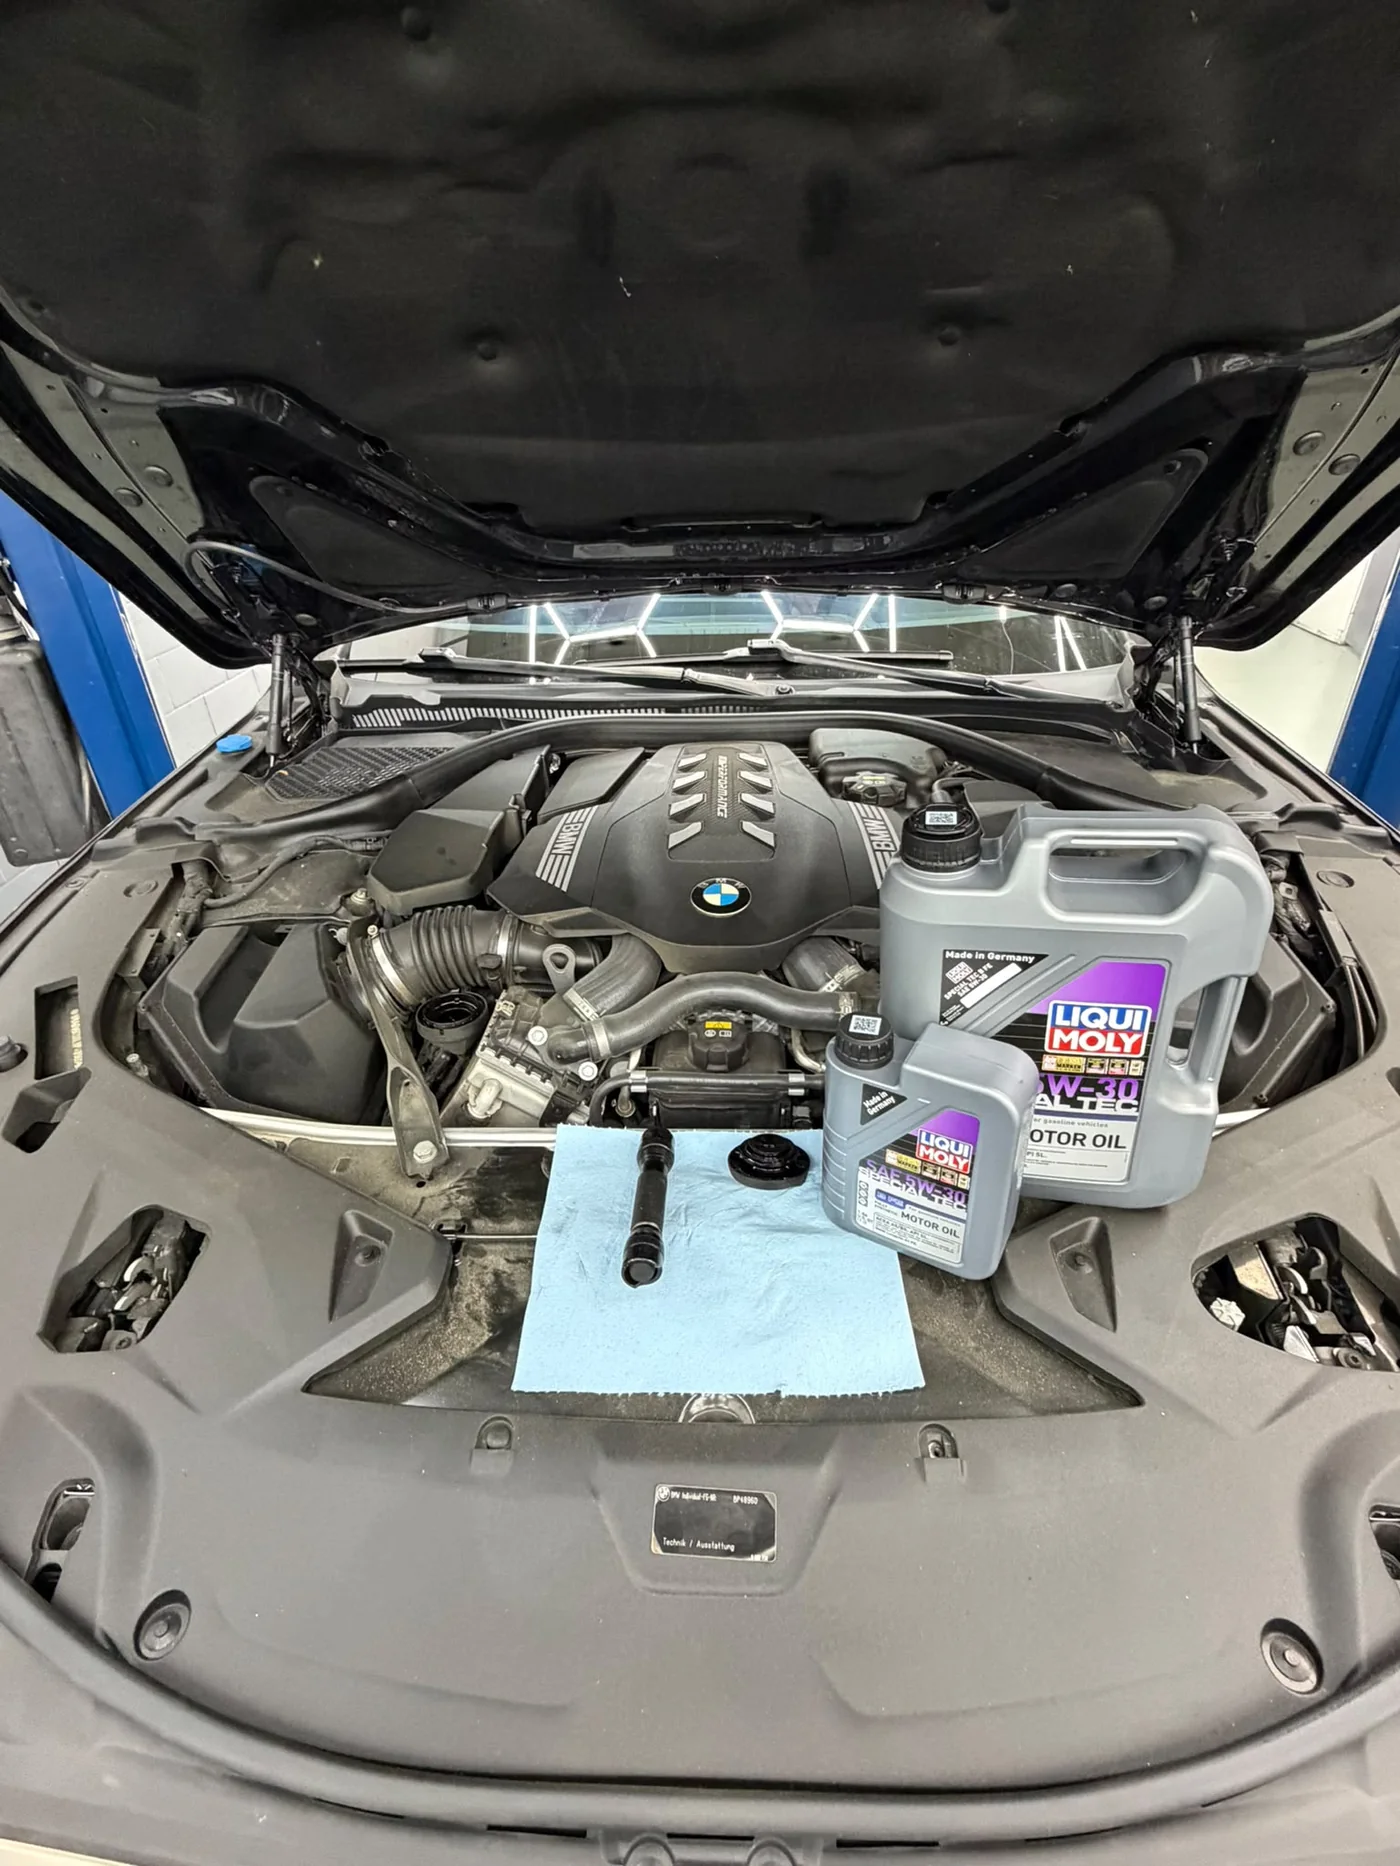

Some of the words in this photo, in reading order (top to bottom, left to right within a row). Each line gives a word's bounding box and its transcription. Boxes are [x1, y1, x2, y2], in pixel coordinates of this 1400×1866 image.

[551, 822, 584, 855] BMW
[863, 818, 897, 850] BMW
[945, 950, 973, 960] Made
[975, 951, 985, 960] in
[986, 952, 1036, 964] Germany
[943, 978, 969, 1000] SPECIAL
[1055, 1005, 1144, 1030] LIQUI
[1052, 1028, 1143, 1053] MOLY
[863, 1095, 881, 1109] Made
[878, 1091, 889, 1100] in
[867, 1095, 896, 1116] Germany
[1077, 1096, 1139, 1113] TEC
[920, 1131, 970, 1158] LIQUI
[1029, 1128, 1087, 1147] OTOR
[1092, 1134, 1127, 1149] OIL
[918, 1145, 970, 1172] MOLY
[858, 1166, 932, 1201] SPECIAL
[931, 1193, 968, 1210] TEC
[905, 1173, 967, 1204] 5W-30
[901, 1211, 940, 1231] MOTOR
[941, 1225, 960, 1239] OIL
[663, 1537, 686, 1547] Technik
[689, 1540, 694, 1548] /
[696, 1541, 735, 1552] Ausstattung
